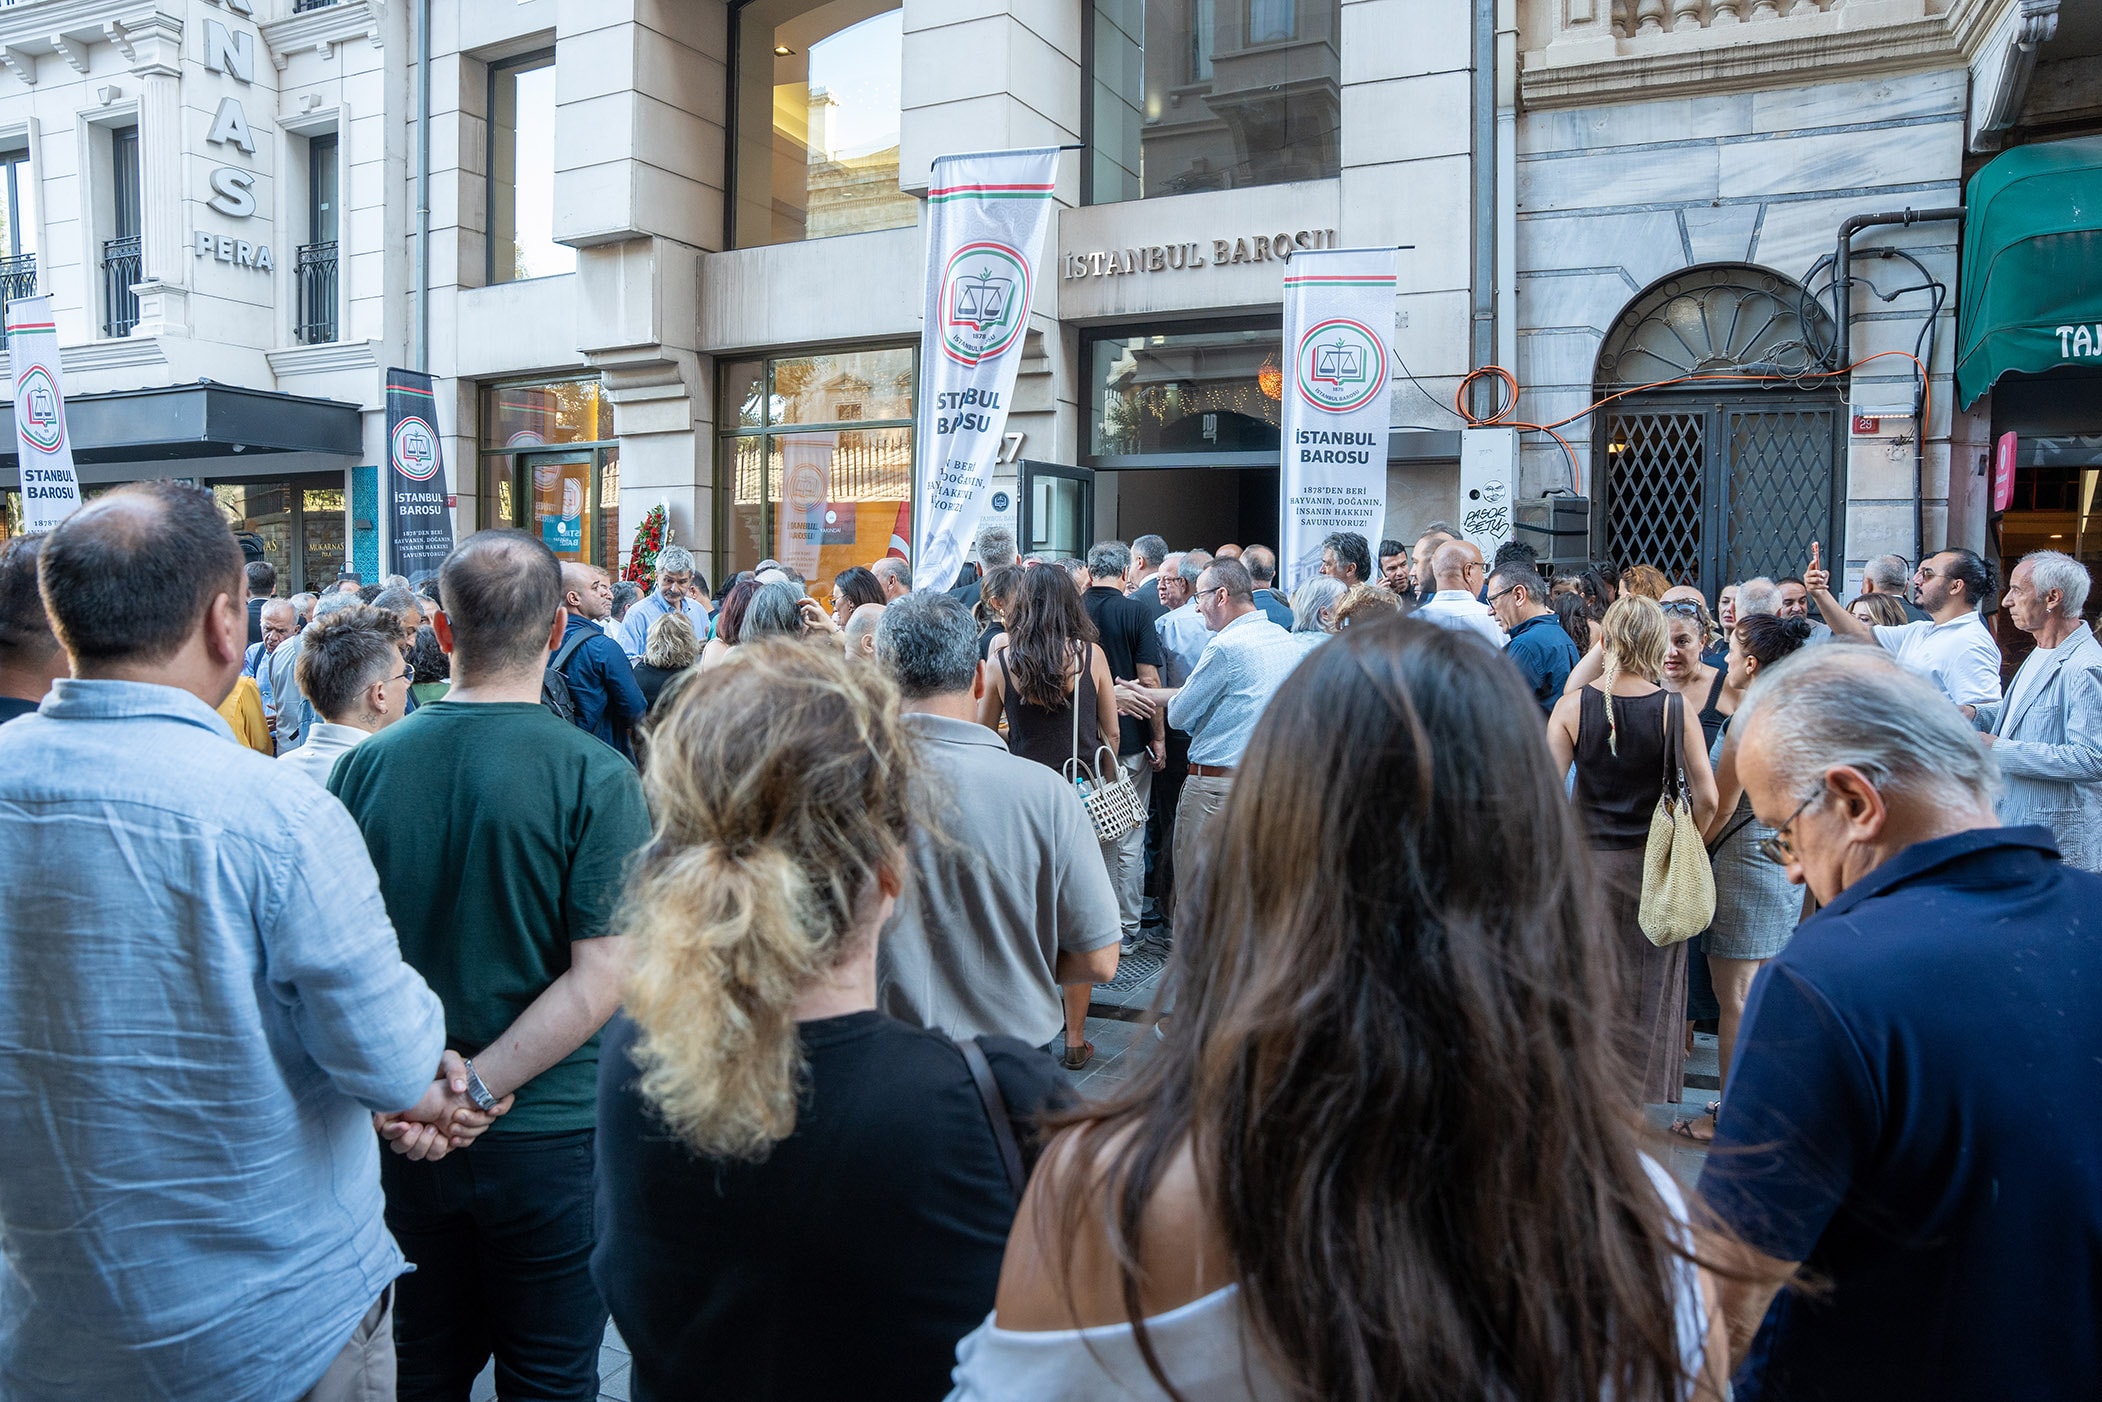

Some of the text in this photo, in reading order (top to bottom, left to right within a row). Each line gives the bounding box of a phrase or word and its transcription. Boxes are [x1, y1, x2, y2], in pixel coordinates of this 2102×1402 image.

[194, 231, 274, 272] PERA
[1064, 241, 1204, 280] İSTANBUL
[1860, 419, 1873, 429] 29
[1296, 428, 1376, 446] İSTANBUL
[1300, 450, 1369, 464] BAROSU
[25, 469, 74, 482] STANBUL
[27, 487, 74, 499] BAROSU
[1346, 487, 1367, 495] BERİ
[395, 492, 443, 503] İSTANBUL
[1290, 497, 1382, 507] HAYVANIN, DOĞANIN,
[400, 505, 441, 515] BAROSU
[1301, 519, 1367, 527] SAVUNUYORUZ!
[309, 542, 344, 551] MUKARNAS
